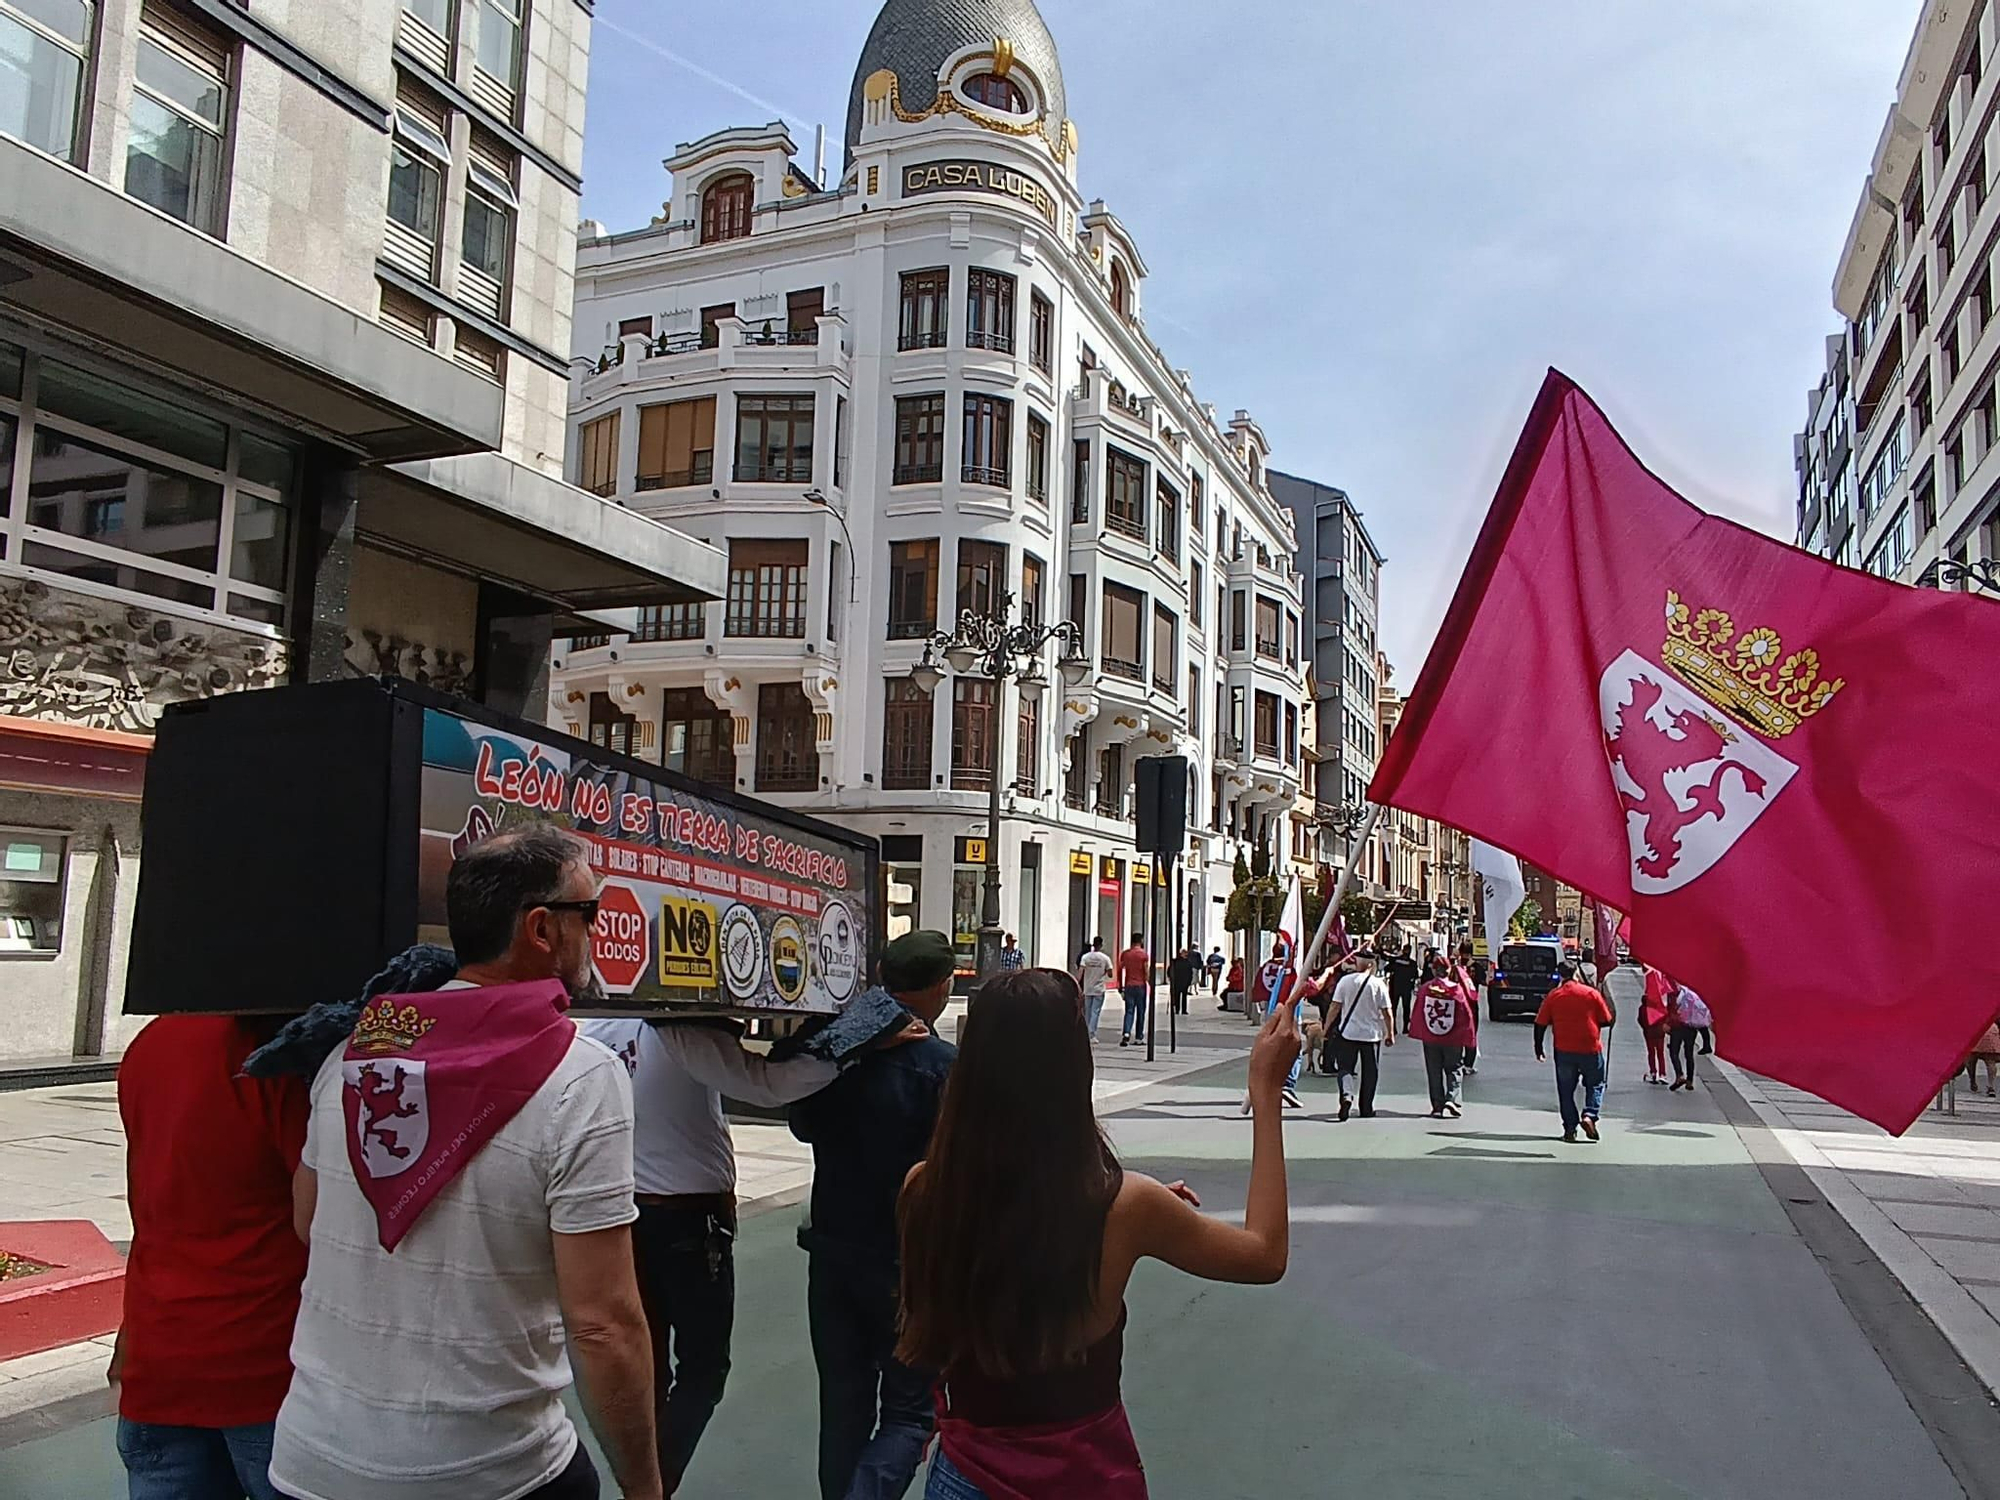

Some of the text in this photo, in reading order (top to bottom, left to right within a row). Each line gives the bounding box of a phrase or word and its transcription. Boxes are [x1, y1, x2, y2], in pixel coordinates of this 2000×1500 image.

[907, 165, 983, 190] CASA
[475, 741, 847, 888] LEÓN NO ES TIERRA DE SACRIFICIO
[642, 853, 659, 876] STOP
[596, 909, 641, 940] STOP
[663, 904, 711, 957] NO
[596, 942, 640, 962] LODOS
